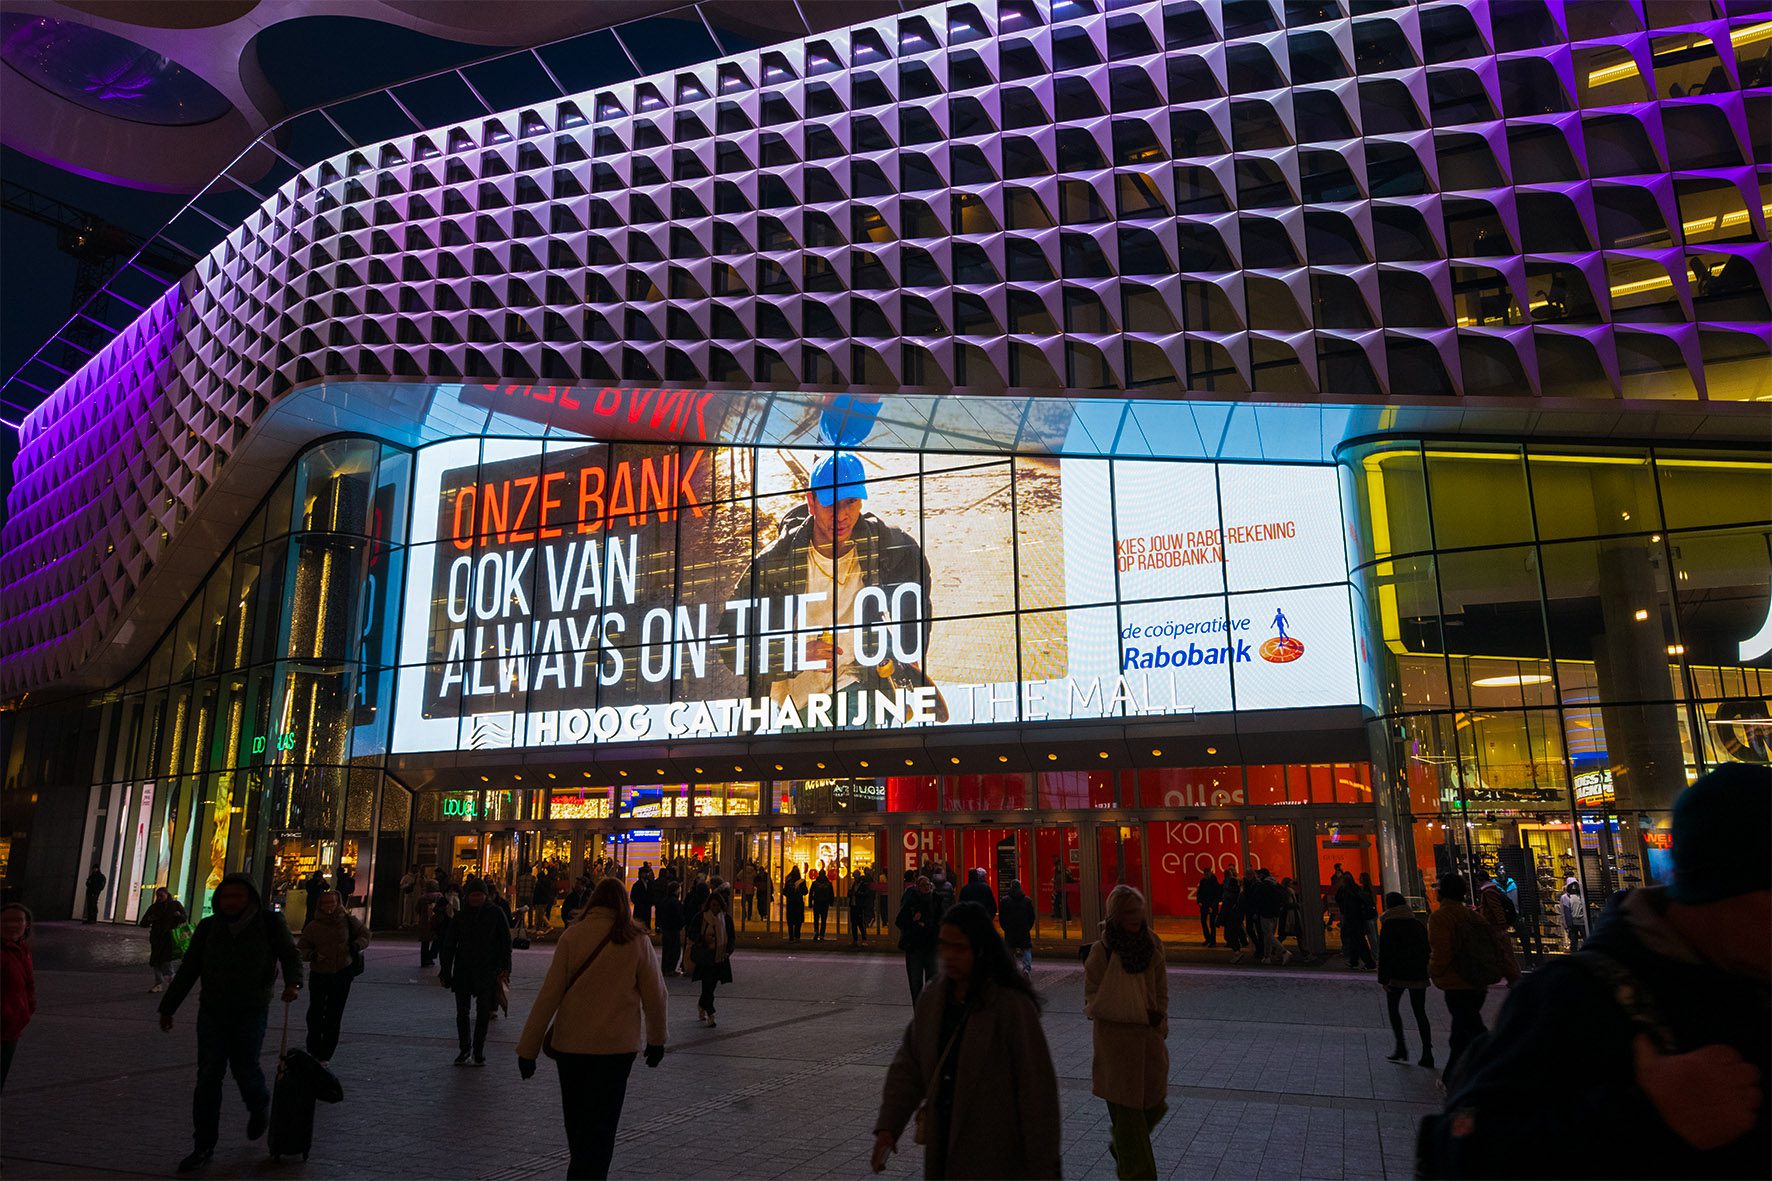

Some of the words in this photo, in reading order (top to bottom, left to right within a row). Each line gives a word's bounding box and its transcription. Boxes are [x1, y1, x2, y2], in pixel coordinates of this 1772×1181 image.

[452, 471, 566, 550] ONZE
[577, 449, 704, 534] BANK
[1117, 537, 1146, 556] KIES
[1148, 533, 1184, 553] JOUW
[1187, 520, 1296, 549] RABO-REKENING
[1118, 555, 1135, 573] OP
[447, 547, 534, 623] OOK
[545, 534, 638, 612] VAN
[439, 612, 626, 698] ALWAYS
[641, 582, 923, 683] ON-THE-GO
[1121, 622, 1142, 640] de
[1144, 616, 1251, 640] coöperatieve
[1123, 638, 1252, 671] Rabobank
[534, 704, 651, 746] HOOG
[663, 686, 937, 736] CATHARIJNE
[958, 680, 1050, 722] THE
[1069, 672, 1196, 717] MALL
[252, 731, 295, 754] DOLAS
[443, 798, 489, 817] DOUGL
[903, 831, 934, 850] OH
[1166, 821, 1238, 844] kom
